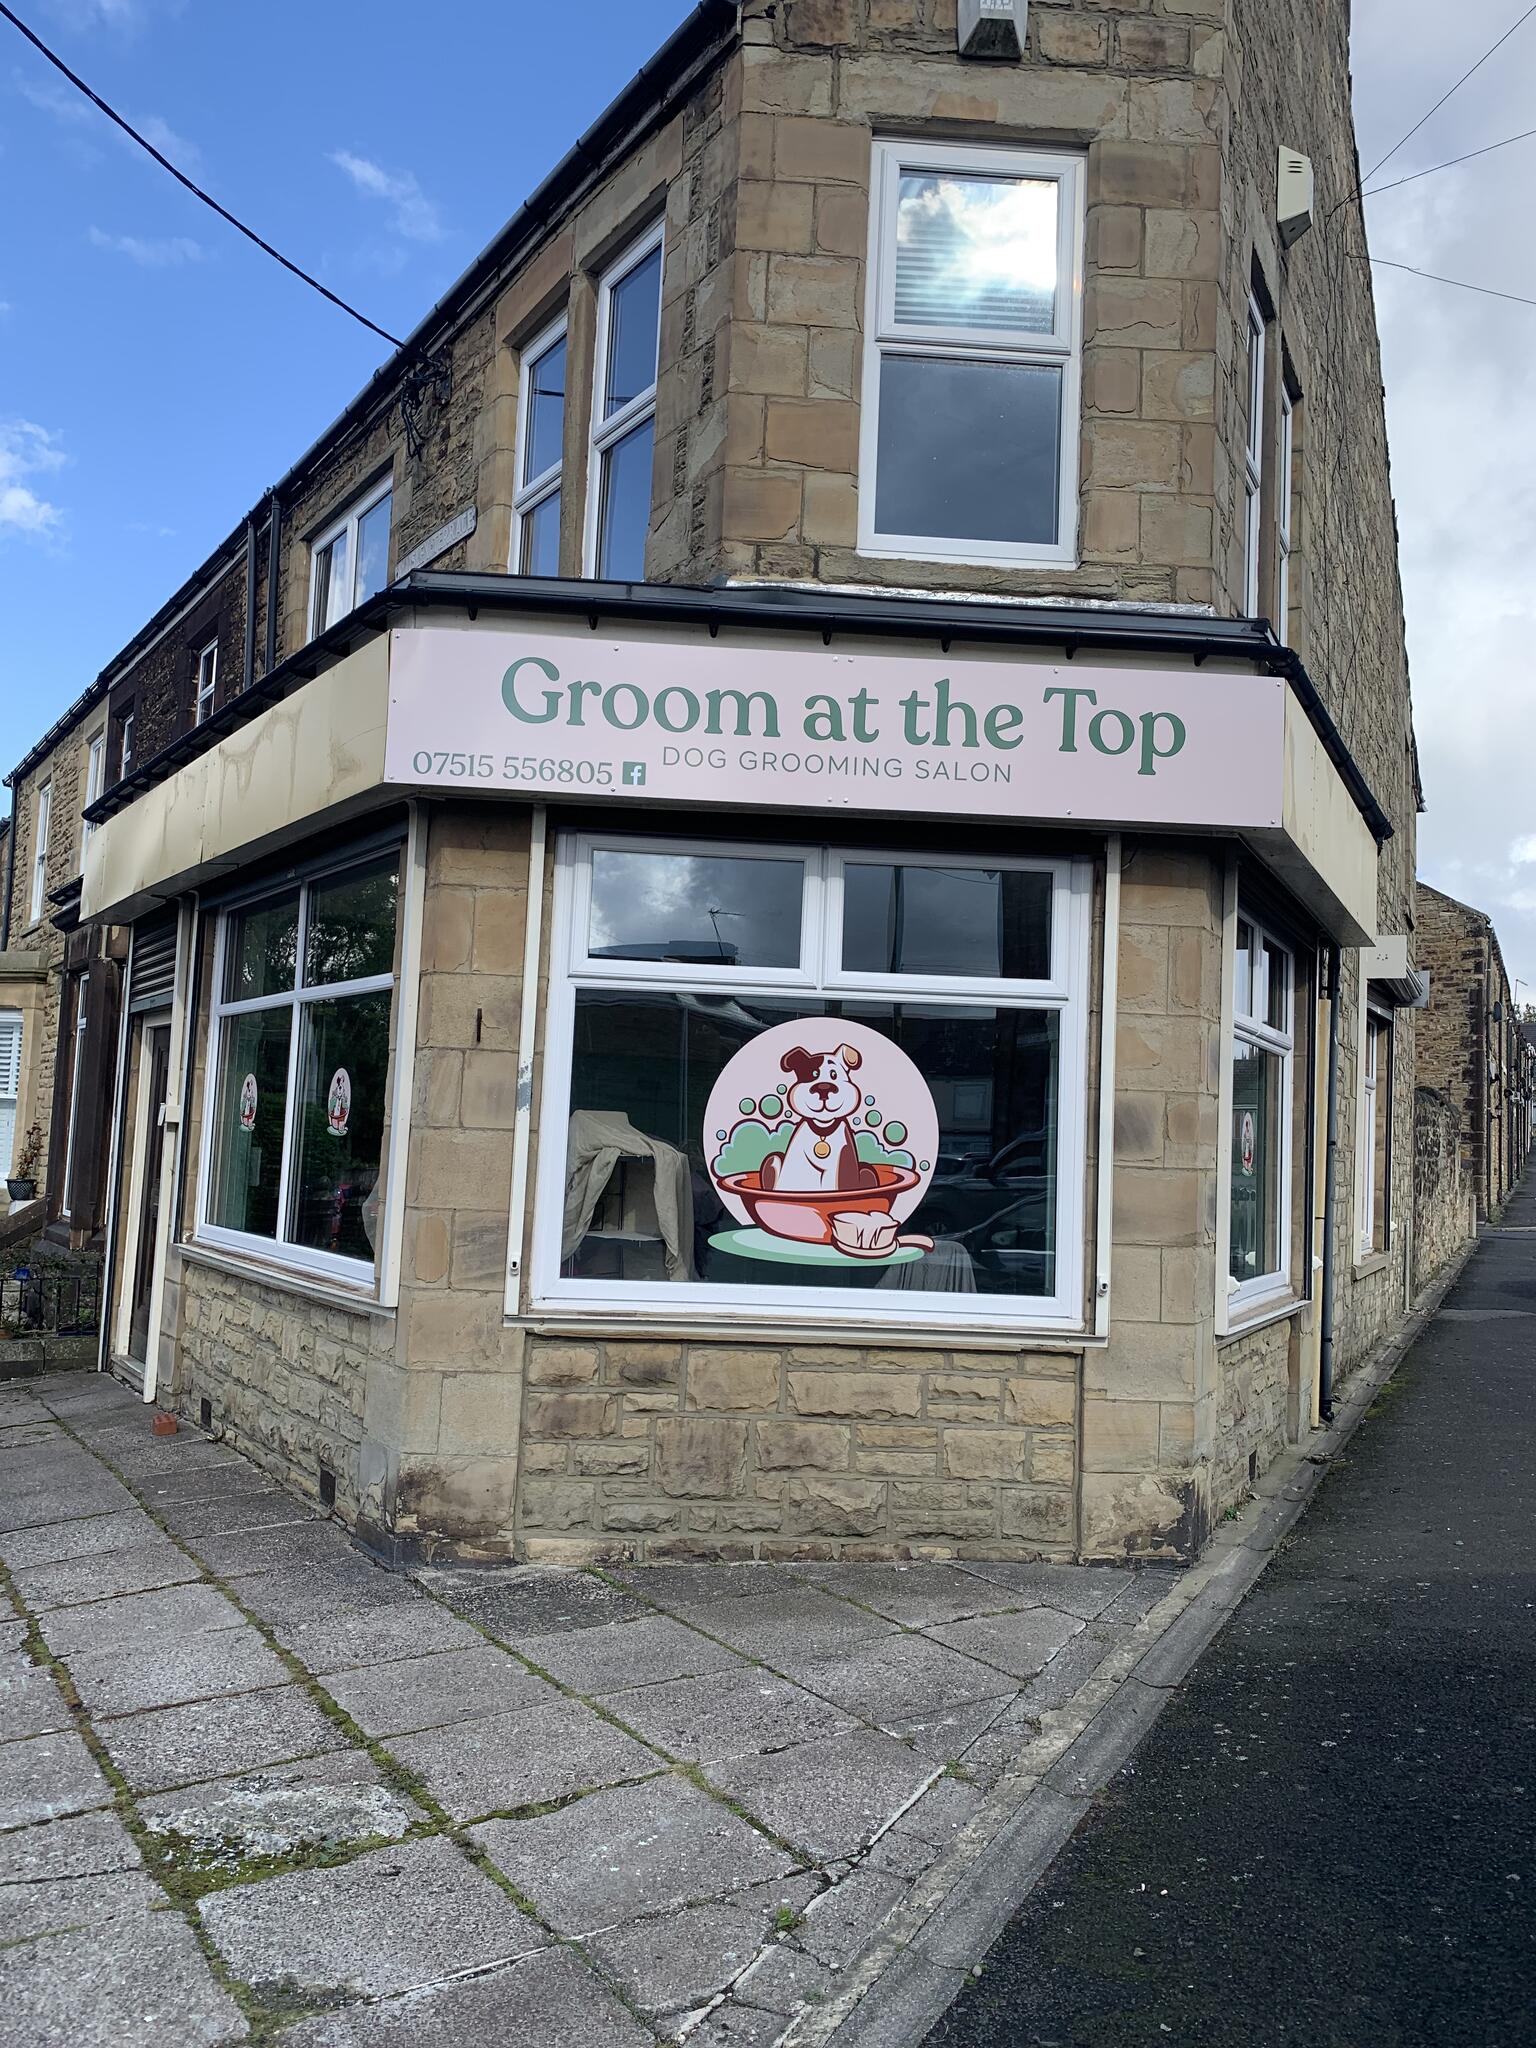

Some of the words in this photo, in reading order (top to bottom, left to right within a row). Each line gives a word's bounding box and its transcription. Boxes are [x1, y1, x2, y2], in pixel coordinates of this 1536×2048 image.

[501, 656, 782, 738] Groom
[802, 687, 880, 744] at
[898, 677, 1025, 751] the
[1042, 686, 1187, 776] Top
[412, 750, 494, 778] 07515
[502, 756, 613, 785] 556805
[663, 746, 726, 769] DOG
[738, 750, 902, 778] GROOMING
[914, 759, 1011, 784] SALON
